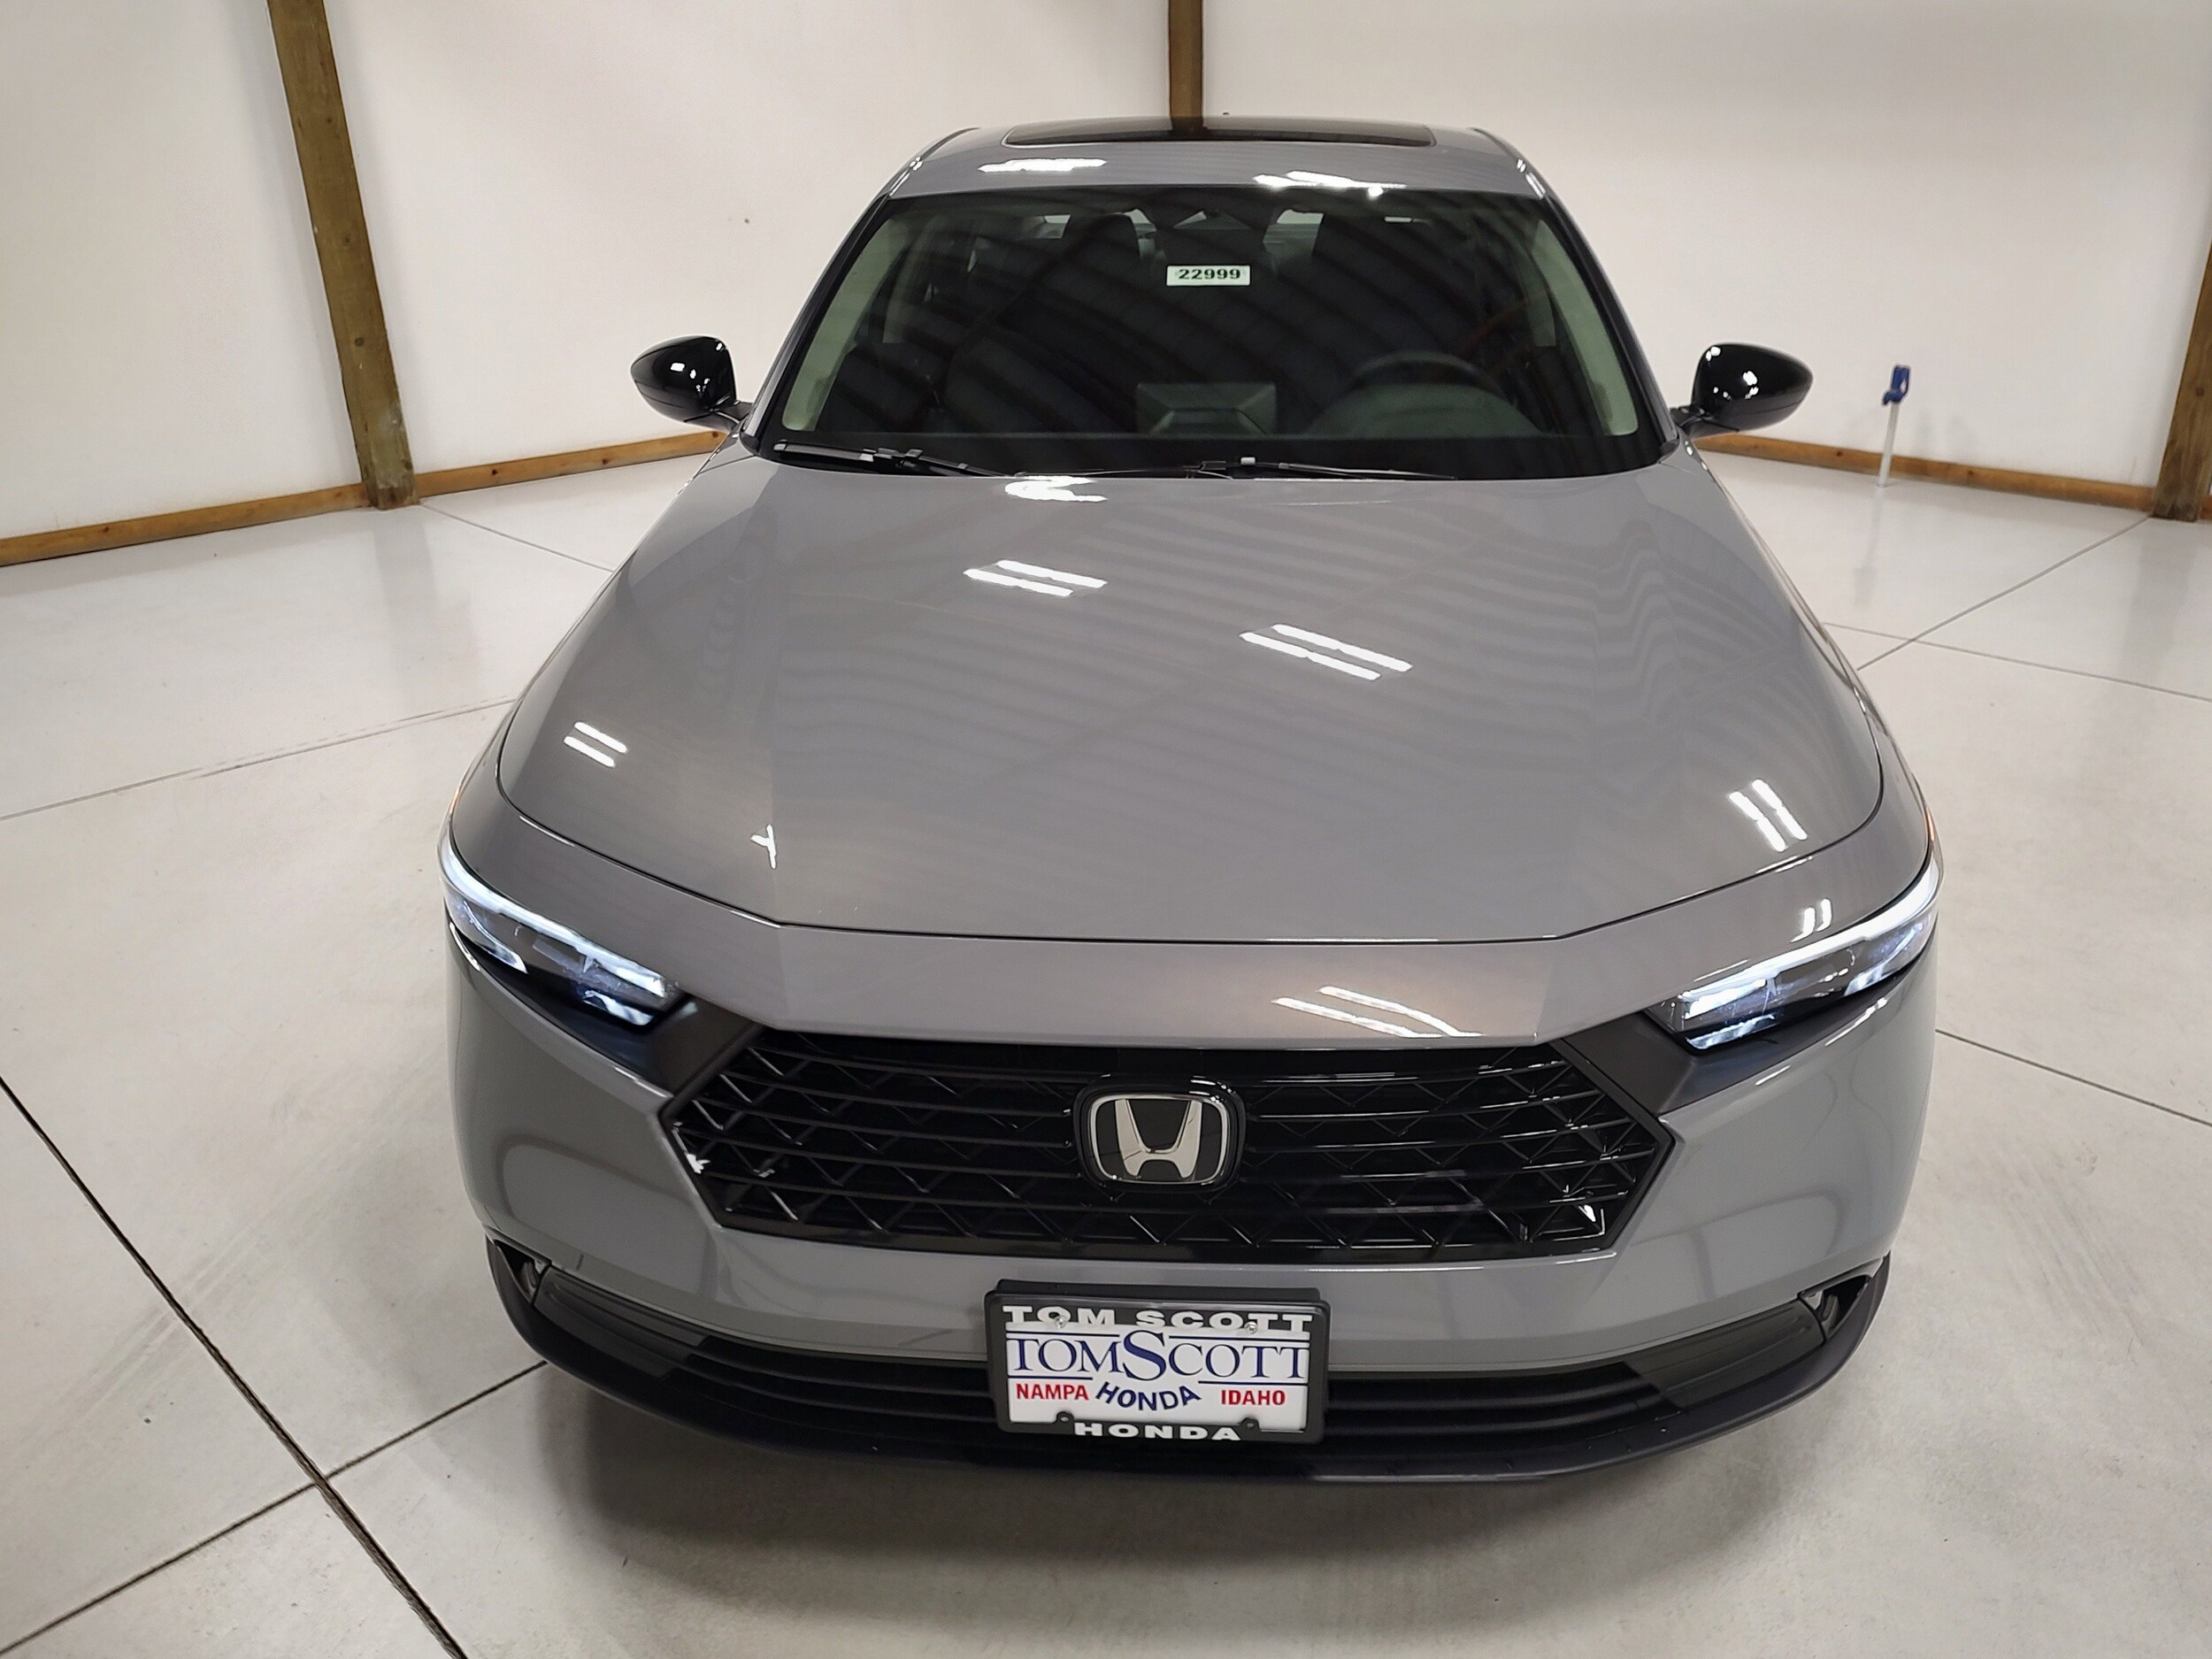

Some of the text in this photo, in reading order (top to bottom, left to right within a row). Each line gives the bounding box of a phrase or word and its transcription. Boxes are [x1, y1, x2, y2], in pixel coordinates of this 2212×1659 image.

[1178, 268, 1241, 280] 22999
[1002, 1305, 1313, 1333] TOM SCOTT
[1016, 1383, 1090, 1402] NAMPA
[1095, 1381, 1202, 1412] HONDA
[1221, 1389, 1286, 1406] IDAHO
[1073, 1422, 1241, 1441] HONDA
